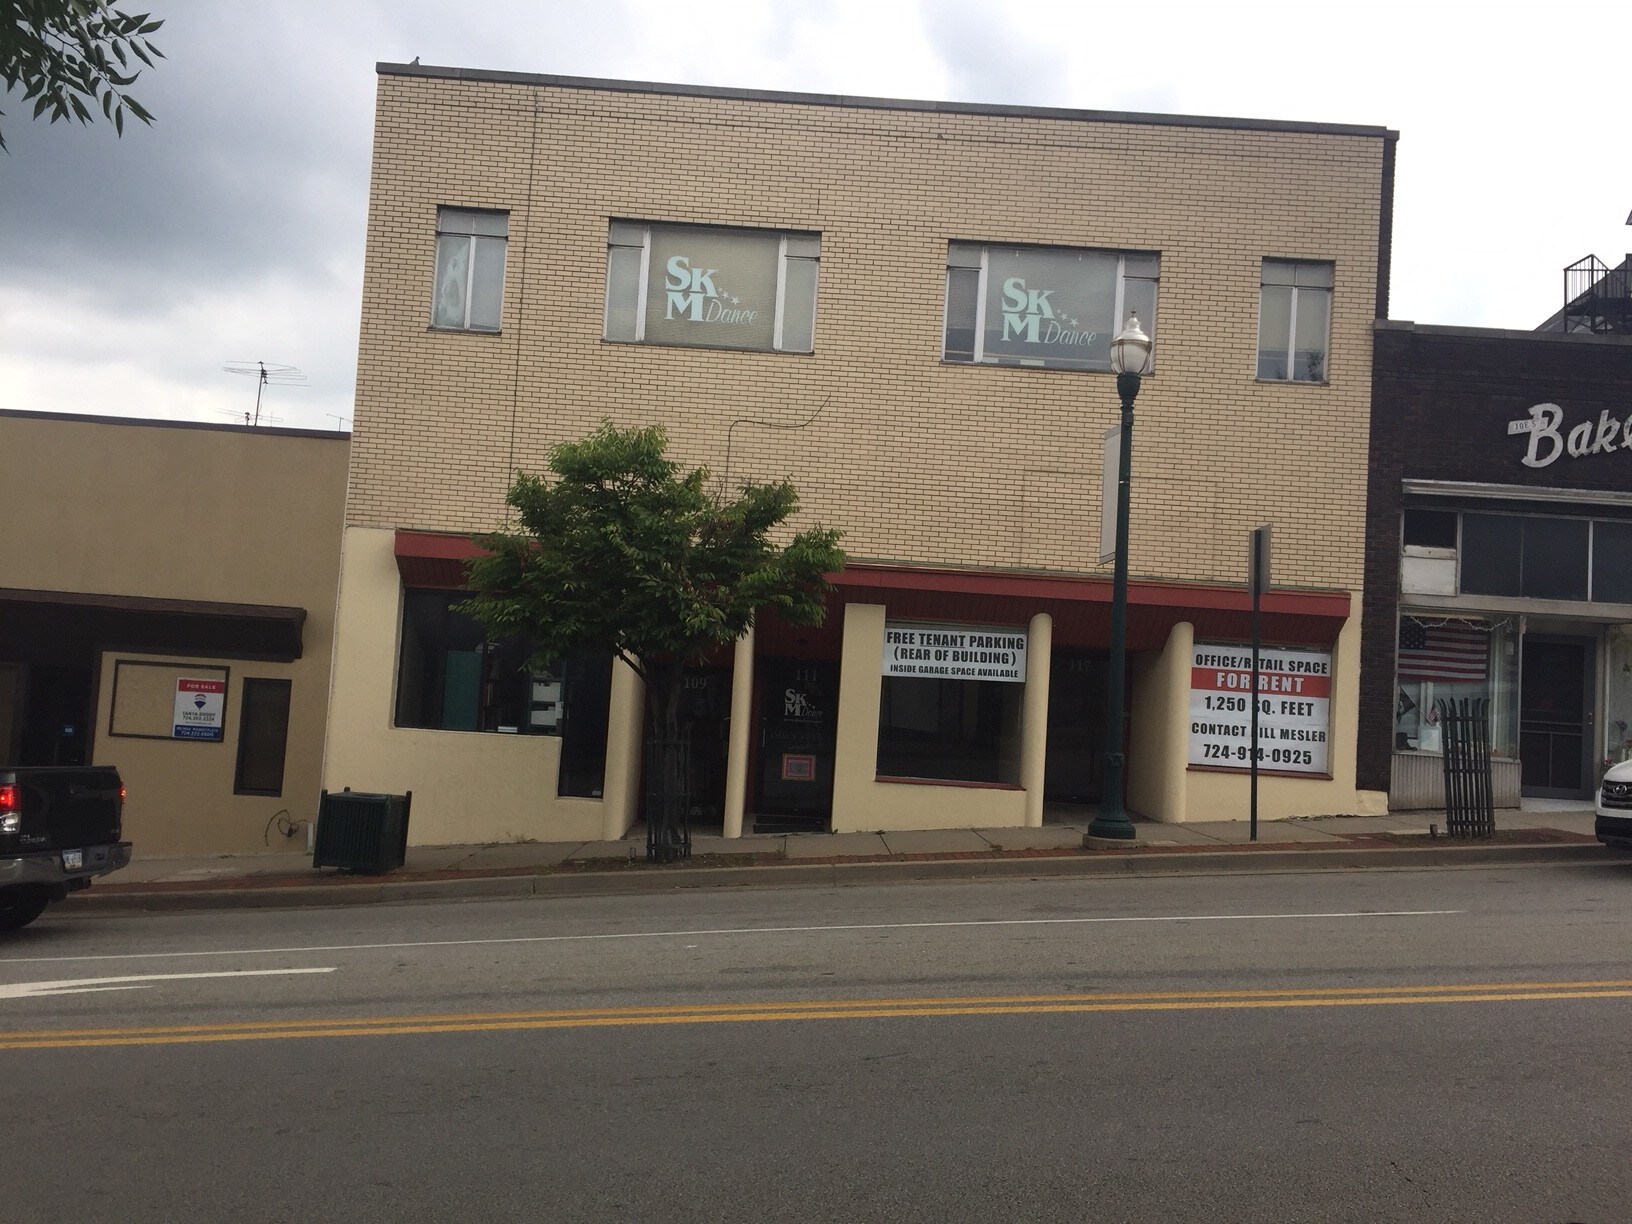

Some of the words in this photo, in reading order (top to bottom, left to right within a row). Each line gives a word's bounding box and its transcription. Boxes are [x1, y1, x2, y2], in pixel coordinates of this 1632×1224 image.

[705, 299, 759, 326] Dance
[1044, 320, 1097, 347] Dance
[886, 631, 915, 645] FREE
[919, 633, 966, 648] TENANT
[969, 635, 1025, 650] PARKING
[893, 645, 931, 662] (REAR
[934, 648, 949, 662] OF
[952, 650, 1017, 667] BUILDING)
[1195, 653, 1285, 671] OFFICE/RTAIL
[1288, 660, 1328, 675] SPACE
[890, 664, 917, 673] INSIDE
[918, 665, 949, 675] GARAGE
[951, 667, 976, 677] SPACE
[977, 668, 1019, 678] AVAILABLE
[1216, 671, 1251, 690] FOR
[1258, 674, 1305, 693] RENT
[683, 677, 707, 690] 109
[1204, 695, 1246, 712] 1,250
[1281, 700, 1314, 717] FEET
[1191, 722, 1247, 738] CONTACT
[1250, 726, 1276, 739] ILL
[1280, 728, 1326, 743] MESLER
